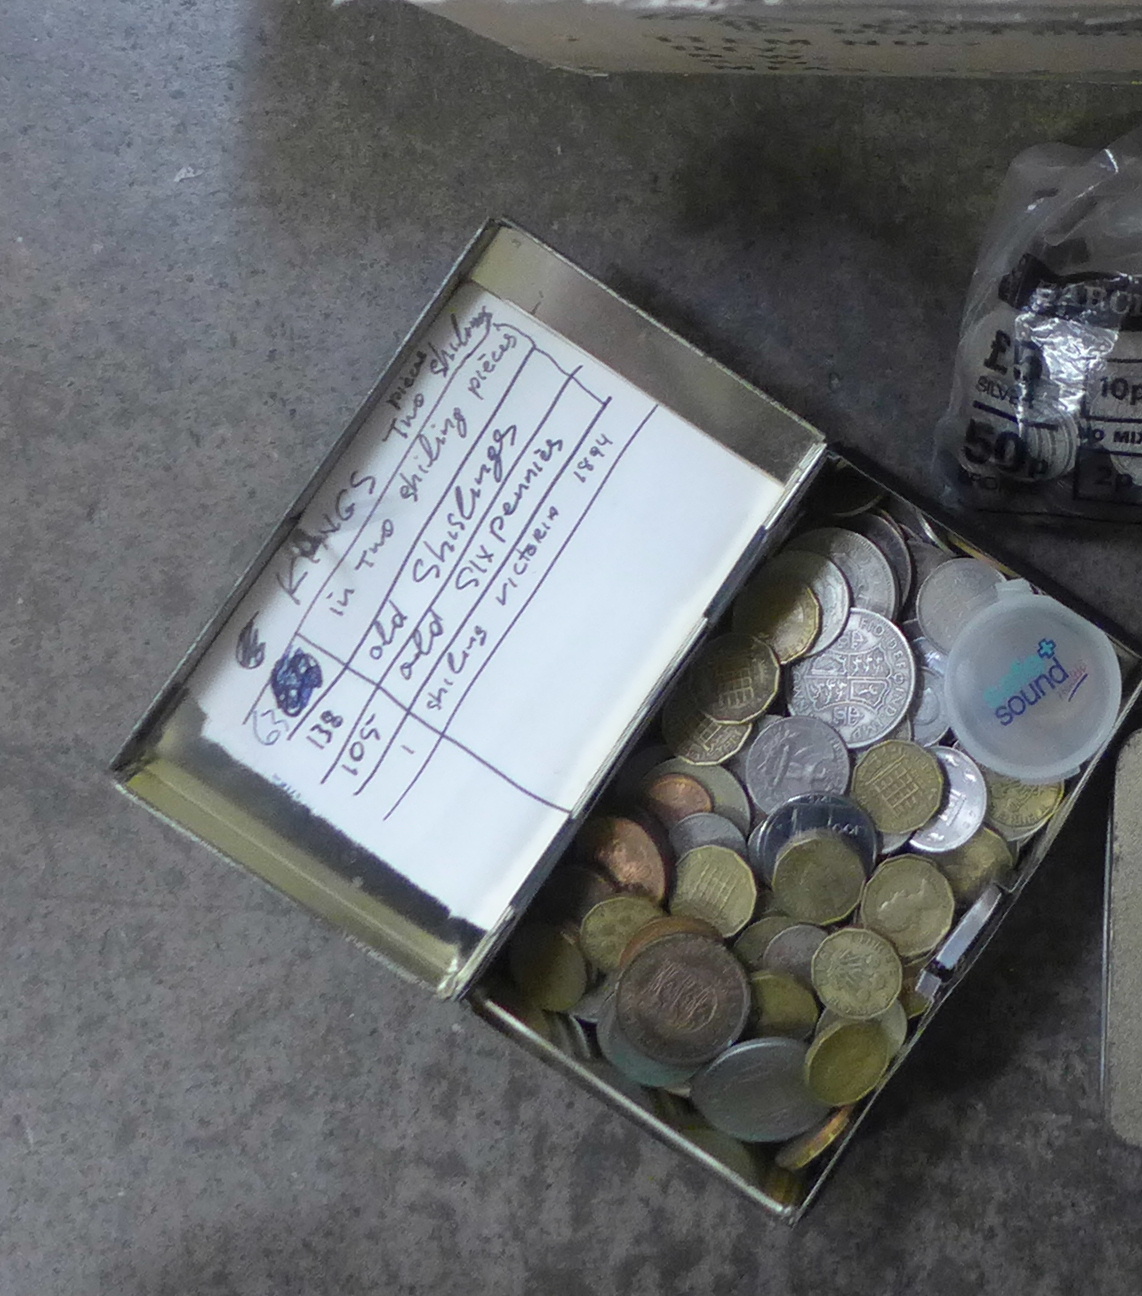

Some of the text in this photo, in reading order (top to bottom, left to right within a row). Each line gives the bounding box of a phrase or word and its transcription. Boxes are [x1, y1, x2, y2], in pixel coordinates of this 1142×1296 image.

[572, 433, 614, 484] 1894
[961, 416, 1050, 479] 50p
[326, 586, 356, 618] in
[368, 599, 409, 661] old
[995, 656, 1070, 727] sound
[305, 709, 344, 751] 138
[340, 712, 381, 777] 105
